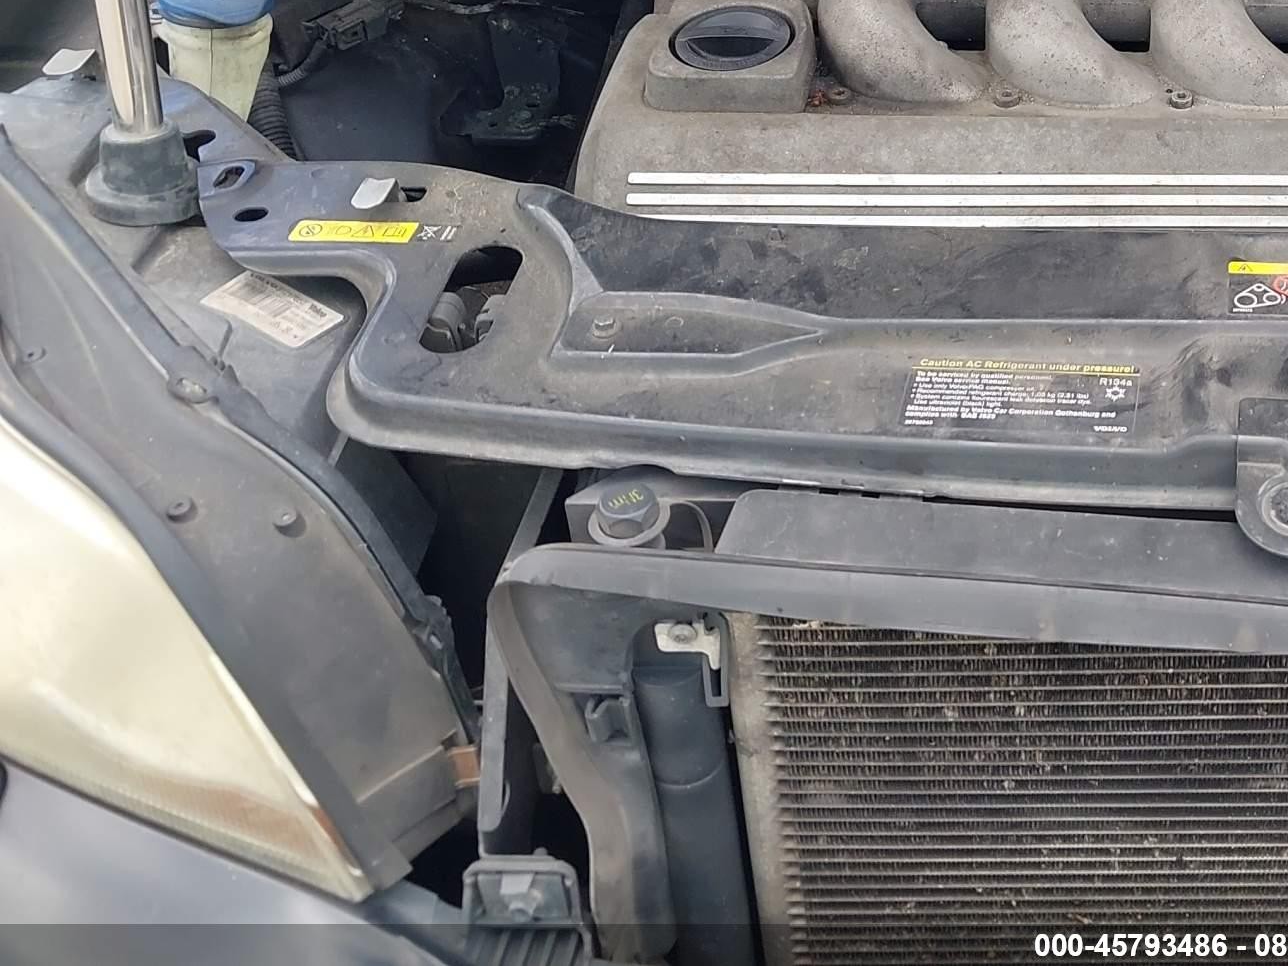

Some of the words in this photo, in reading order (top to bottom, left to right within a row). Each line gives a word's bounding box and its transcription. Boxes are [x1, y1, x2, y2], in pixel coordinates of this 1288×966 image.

[920, 358, 962, 367] Caution
[984, 361, 1045, 370] Refrigerant
[1083, 364, 1134, 373] pressure!
[1099, 378, 1132, 386] R134a
[1055, 410, 1099, 418] Gothenburg
